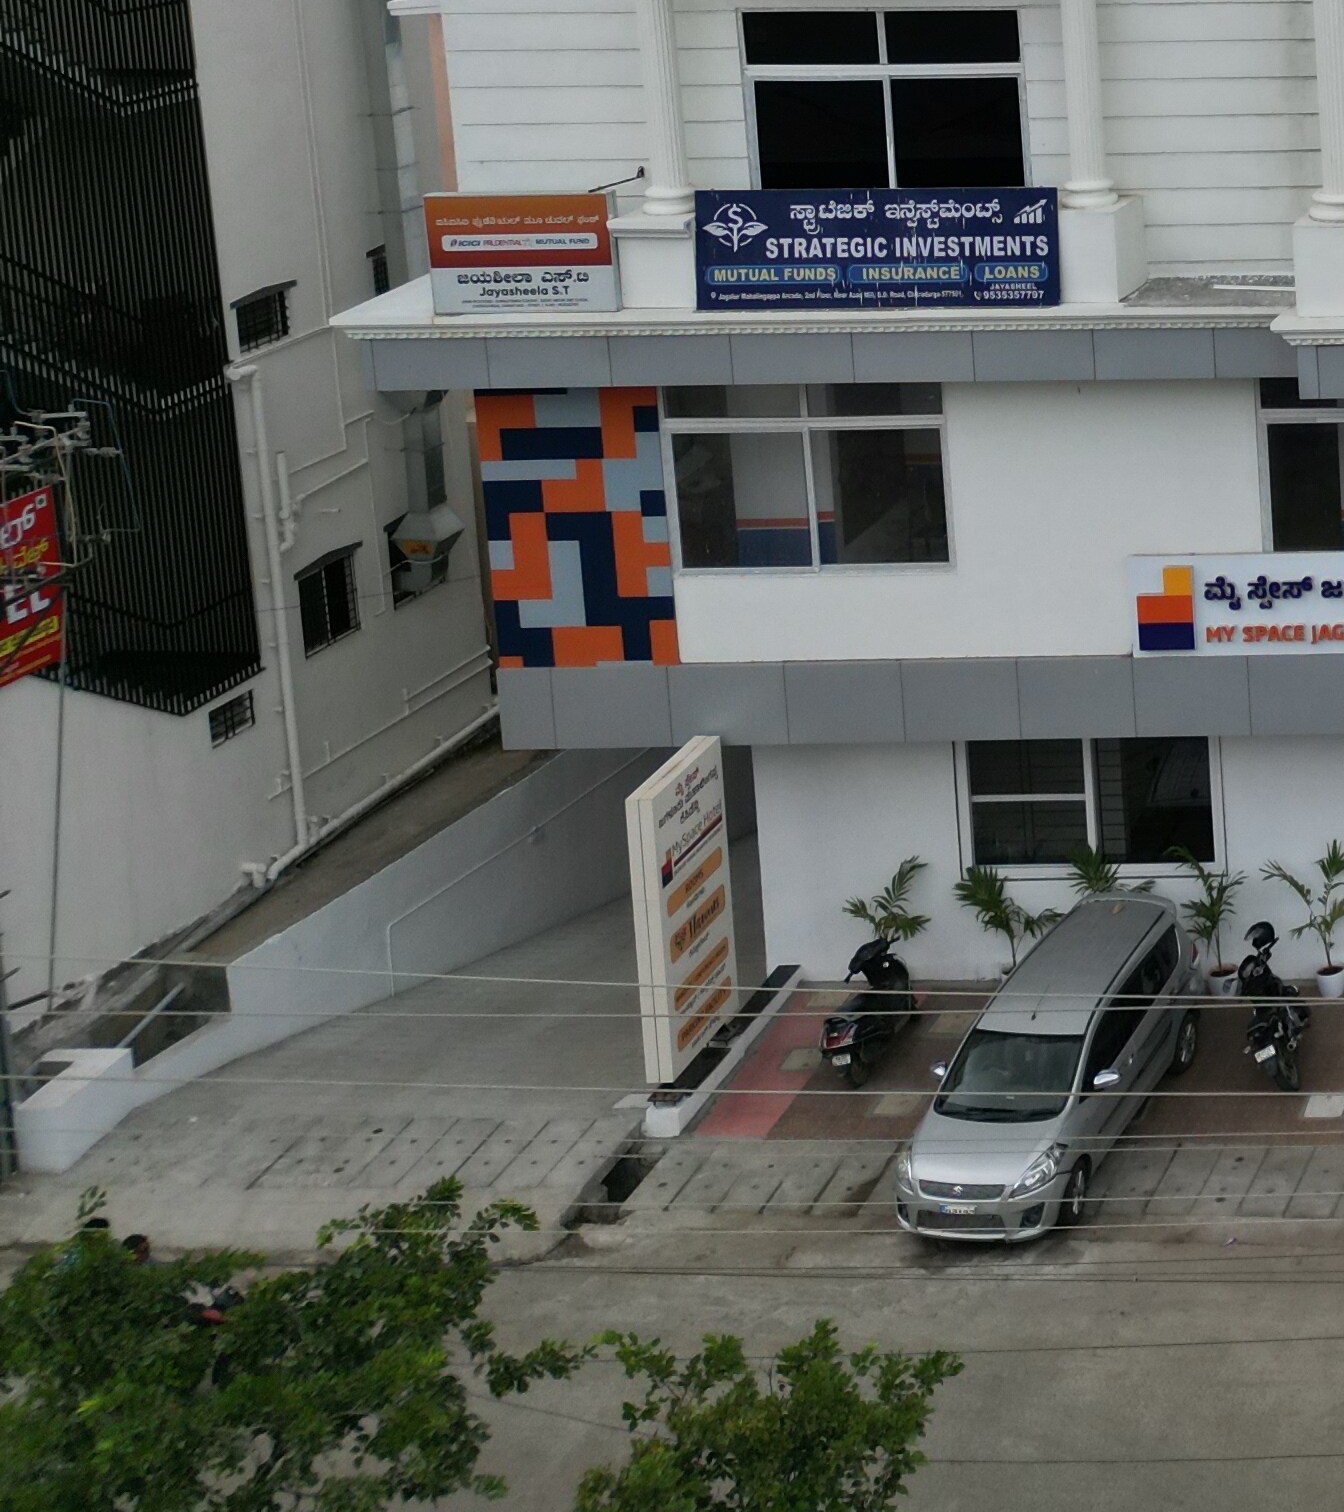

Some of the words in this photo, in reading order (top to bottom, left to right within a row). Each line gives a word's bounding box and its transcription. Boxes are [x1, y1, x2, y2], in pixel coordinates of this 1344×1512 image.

[765, 237, 889, 259] STRATEGIC
[895, 236, 1050, 259] INVESTMENTS
[714, 268, 780, 282] MUTUAL
[783, 267, 837, 281] FUNDS
[862, 265, 961, 280] INSURANCE
[984, 265, 1041, 279] LOANS
[479, 286, 549, 298] Jayasheela
[1203, 575, 1242, 611] ಮೈ
[1205, 624, 1238, 643] MY
[1242, 623, 1306, 642] SPACE
